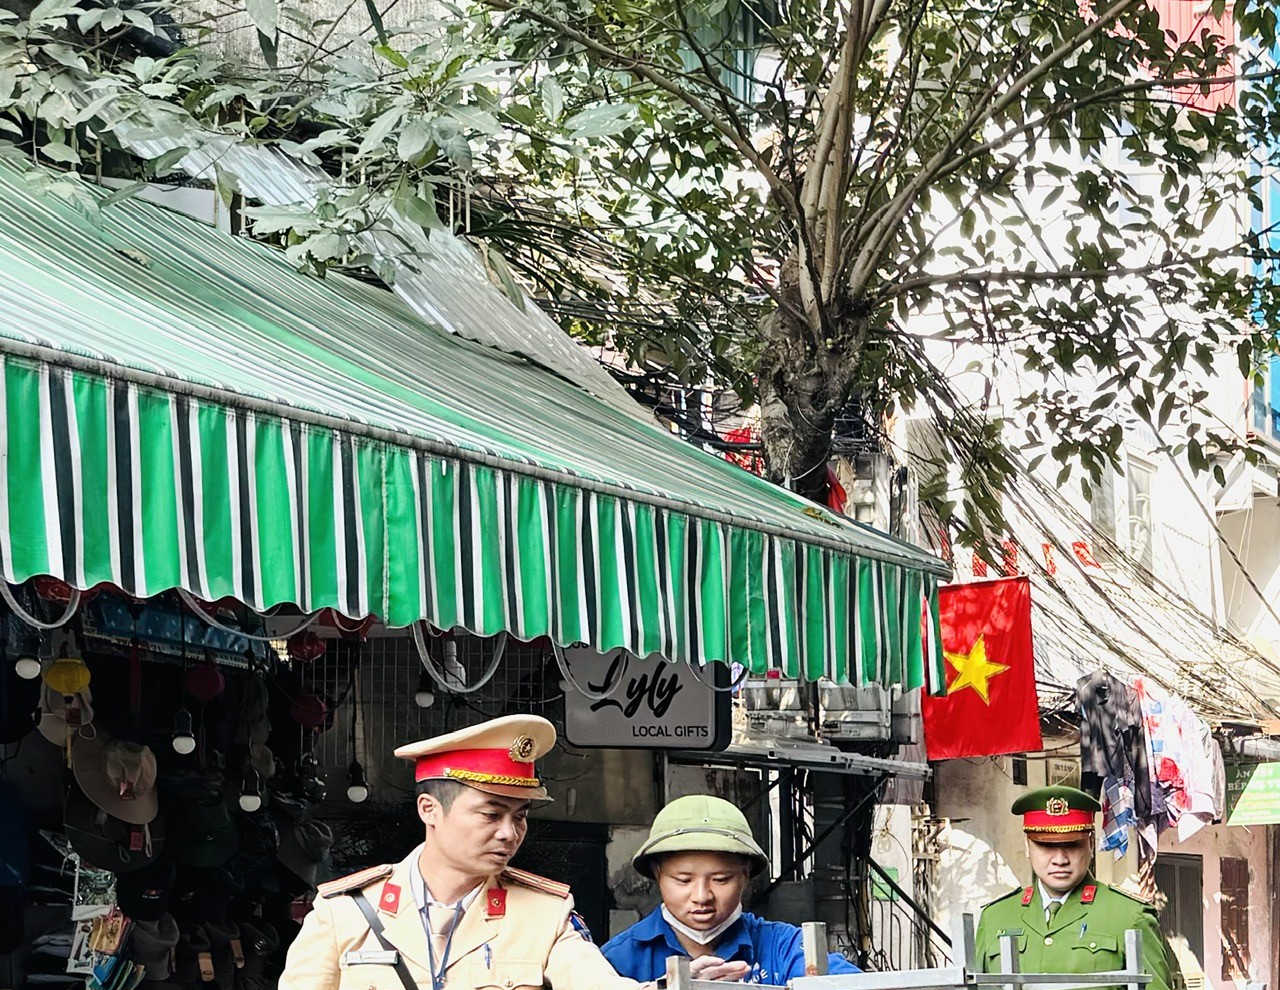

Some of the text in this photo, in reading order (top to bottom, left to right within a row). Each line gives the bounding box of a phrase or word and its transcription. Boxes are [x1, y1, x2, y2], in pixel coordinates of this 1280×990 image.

[588, 653, 683, 719] Lyly
[632, 725, 709, 738] LOCAL GIFTS
